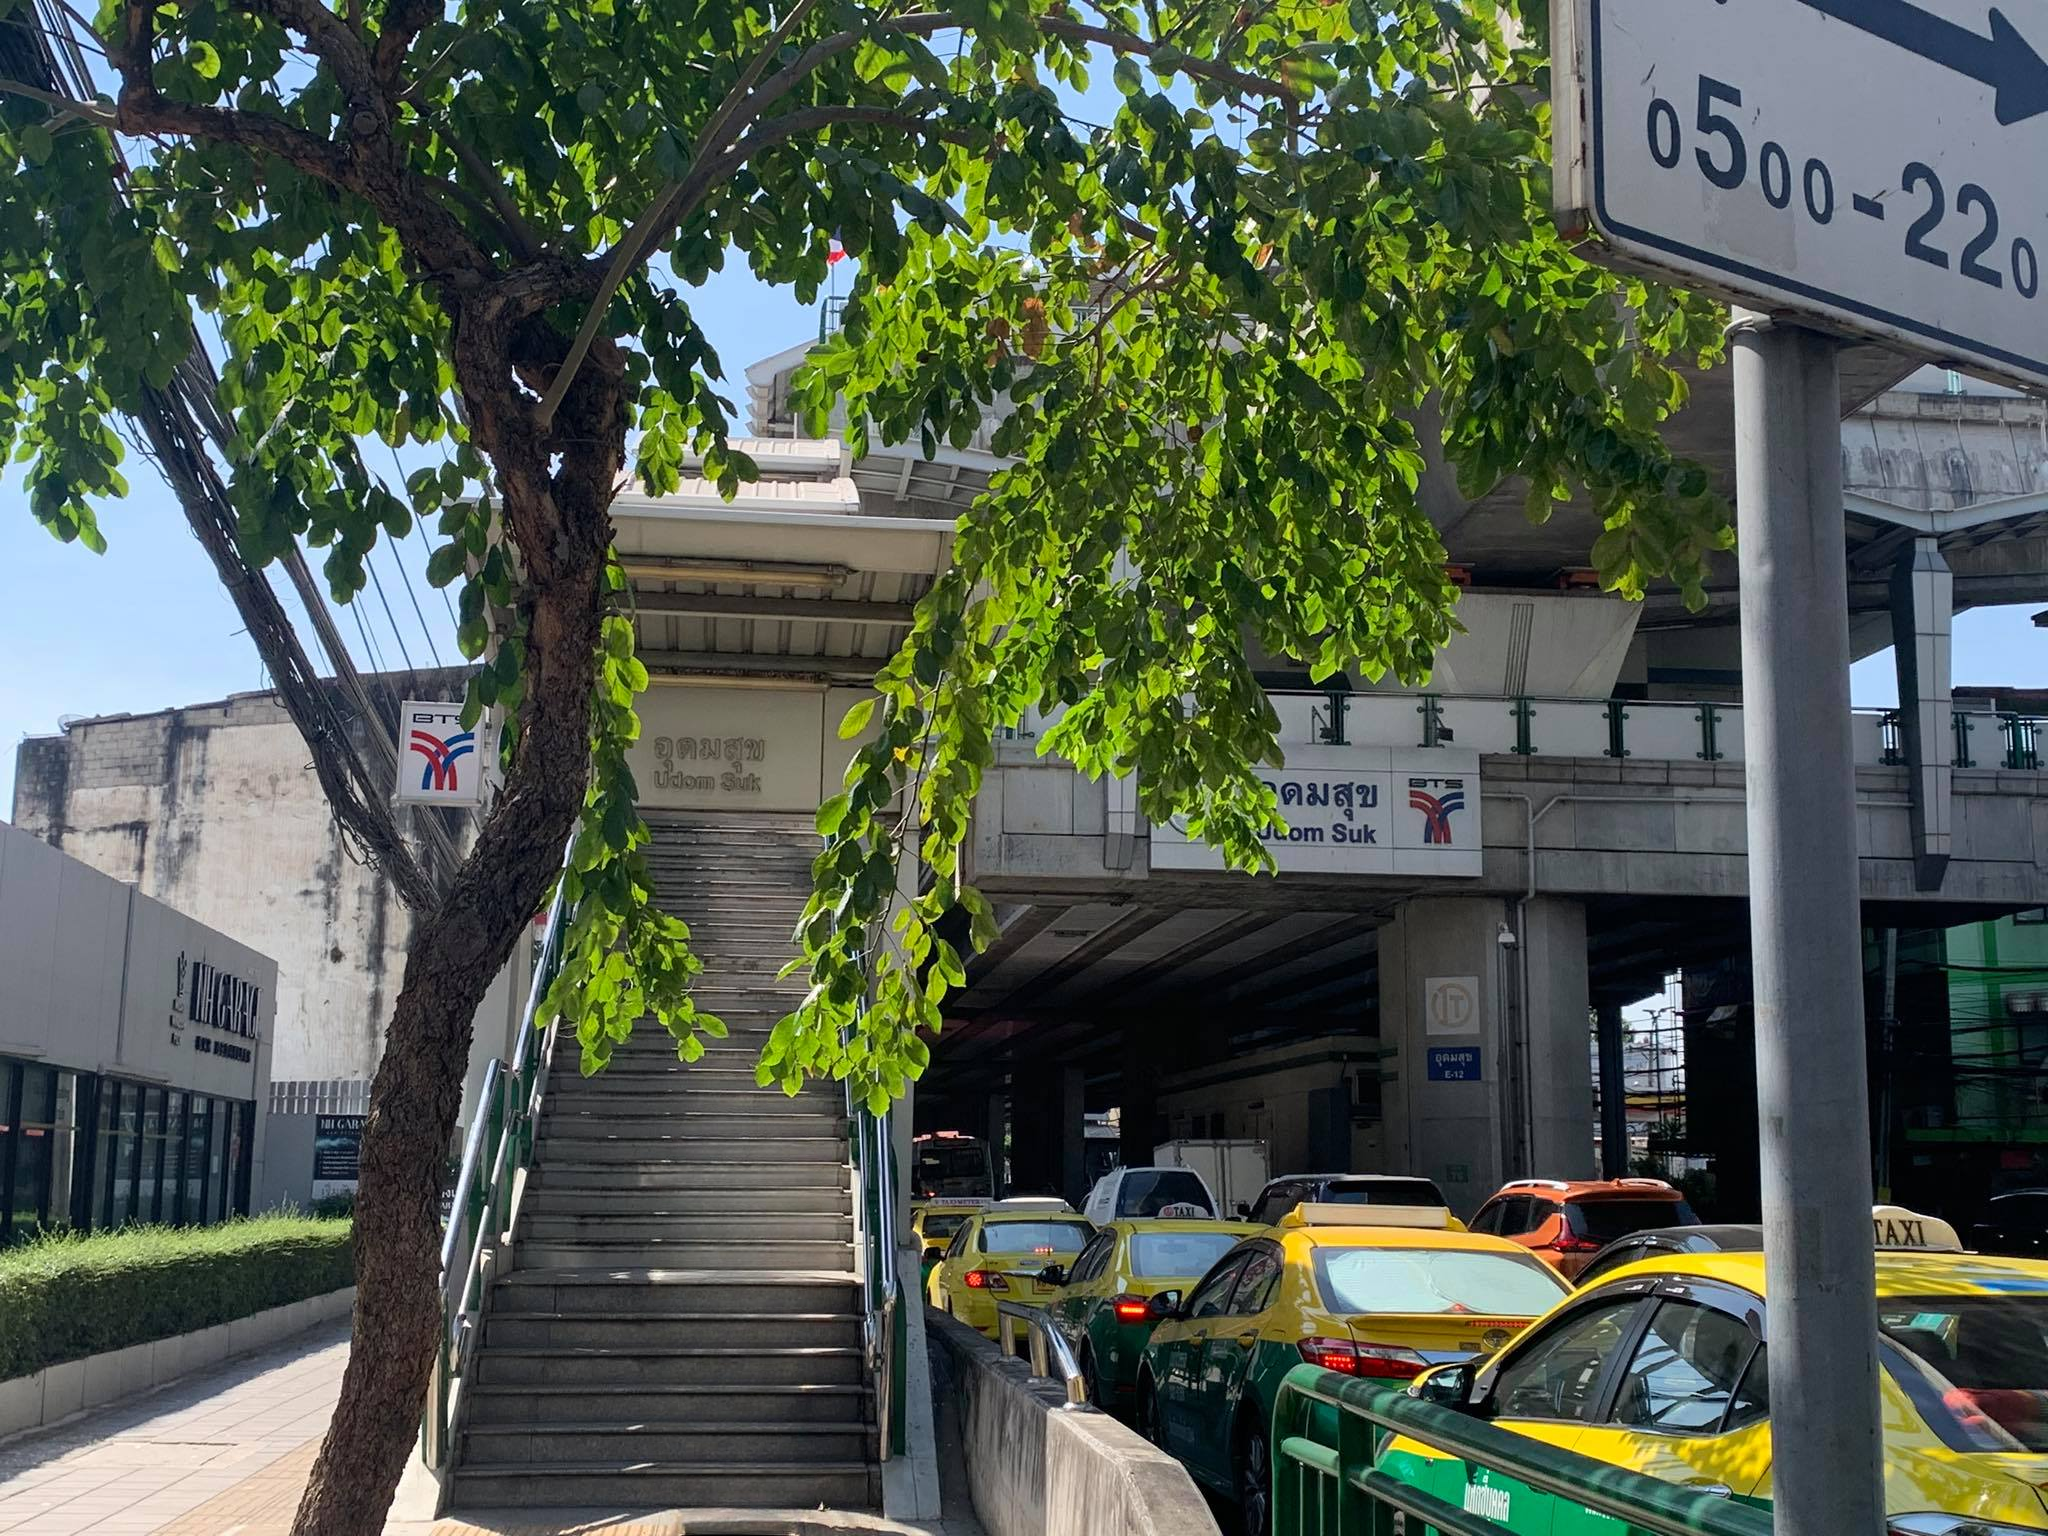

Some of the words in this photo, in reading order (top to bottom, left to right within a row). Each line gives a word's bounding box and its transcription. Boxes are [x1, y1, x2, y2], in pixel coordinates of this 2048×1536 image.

[654, 736, 766, 774] อุดมสุข
[654, 771, 716, 791] Udom
[721, 772, 762, 792] Suk
[1408, 777, 1464, 790] BTS
[1331, 822, 1377, 845] Suk
[1173, 1206, 1195, 1217] TAXI
[1872, 1218, 1928, 1247] TAXI
